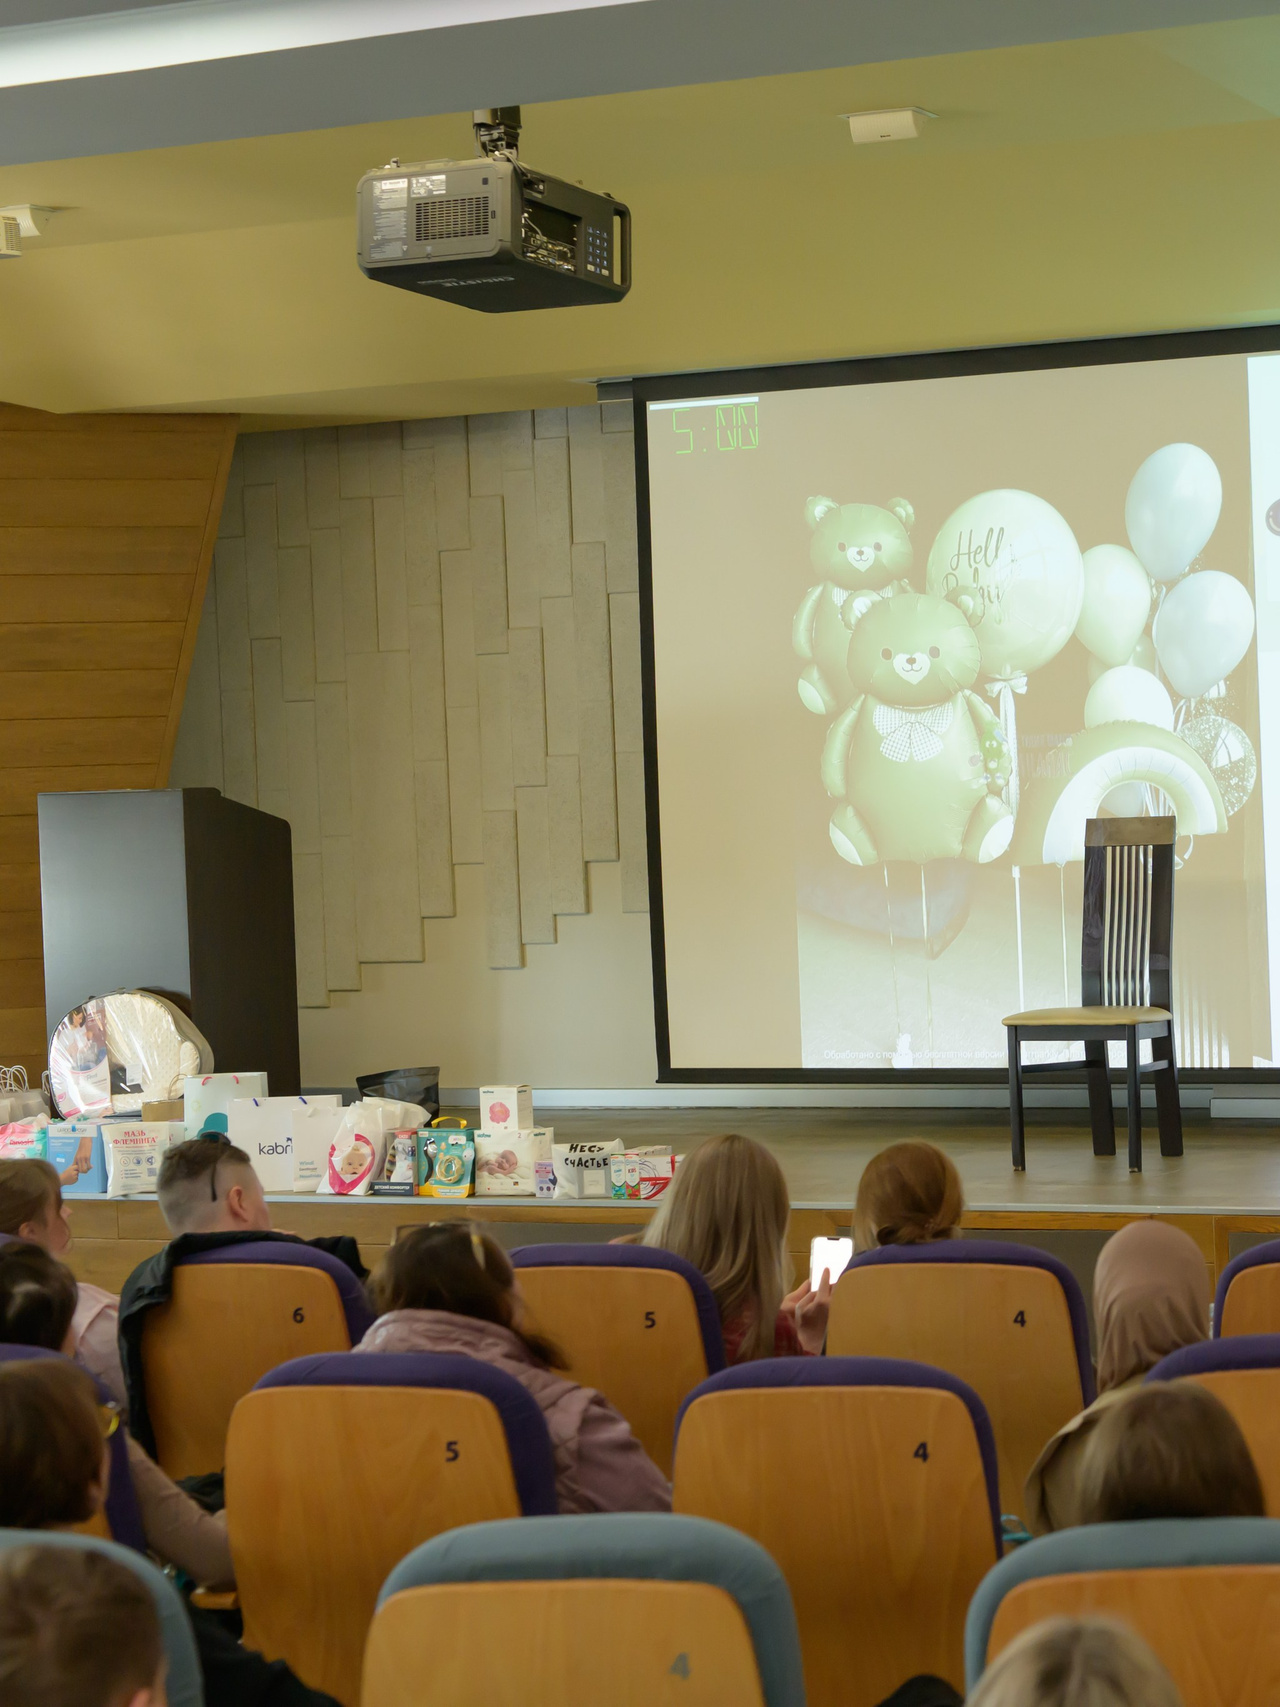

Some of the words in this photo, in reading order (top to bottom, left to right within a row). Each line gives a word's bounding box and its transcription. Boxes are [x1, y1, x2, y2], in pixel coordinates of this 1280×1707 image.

[672, 403, 759, 454] 5:00
[949, 526, 1014, 572] Hell
[123, 1129, 146, 1138] МАЗЬ
[564, 1157, 609, 1168] СЧАСТЬЕ
[292, 1307, 305, 1324] 6
[644, 1311, 657, 1329] 5
[1013, 1310, 1027, 1328] 4
[445, 1440, 460, 1463] 5
[913, 1441, 930, 1463] 4
[669, 1652, 691, 1681] 4
